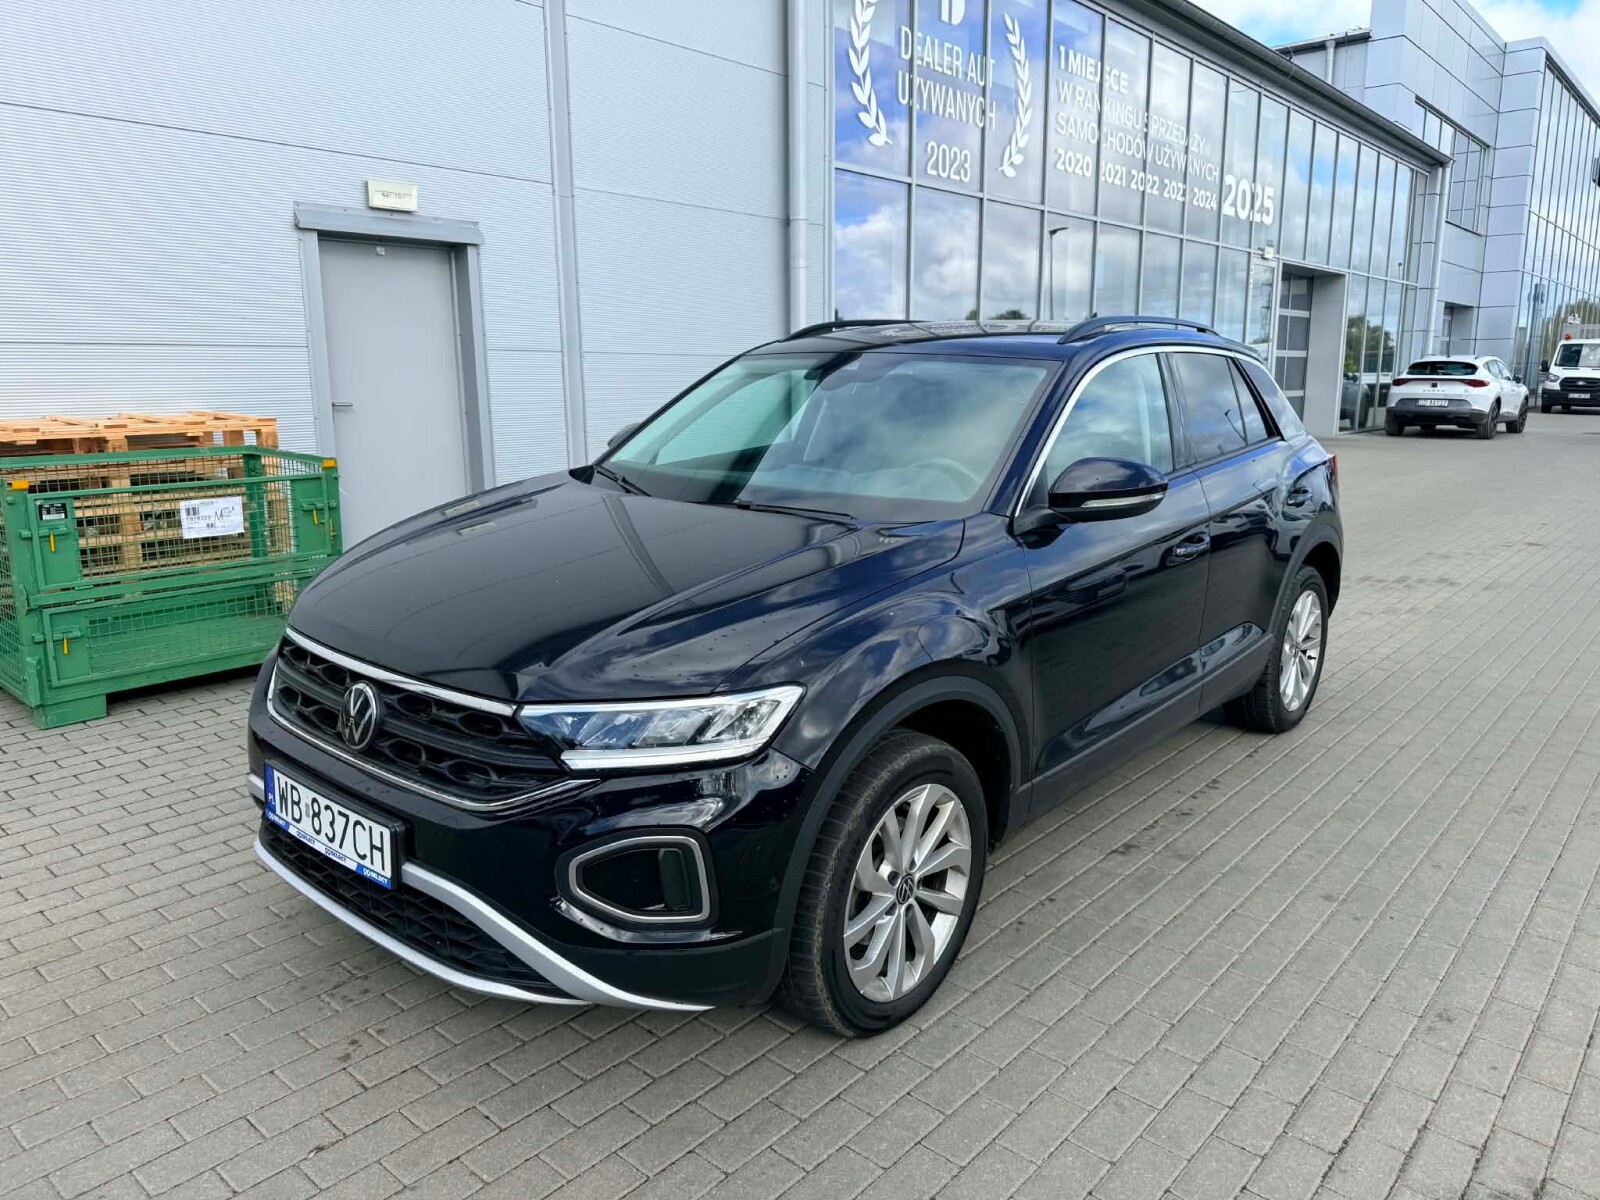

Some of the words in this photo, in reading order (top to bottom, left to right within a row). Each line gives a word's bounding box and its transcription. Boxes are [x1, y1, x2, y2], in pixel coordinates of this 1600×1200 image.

[901, 25, 963, 79] DEALER
[968, 51, 996, 88] AUT
[1059, 45, 1066, 69] 1
[1068, 49, 1128, 94] MIEJSCE
[1058, 78, 1073, 104] W
[1075, 86, 1142, 128] RANKINGU
[926, 140, 971, 182] 2023
[1155, 143, 1219, 183] UŻYWANYCH
[1056, 148, 1092, 178] 2020
[1101, 160, 1126, 187] 2021
[1130, 169, 1159, 195] 2022
[1192, 186, 1217, 211] 2024
[1222, 174, 1275, 226] 2025
[277, 775, 303, 825] WB
[310, 796, 385, 872] 837CH
